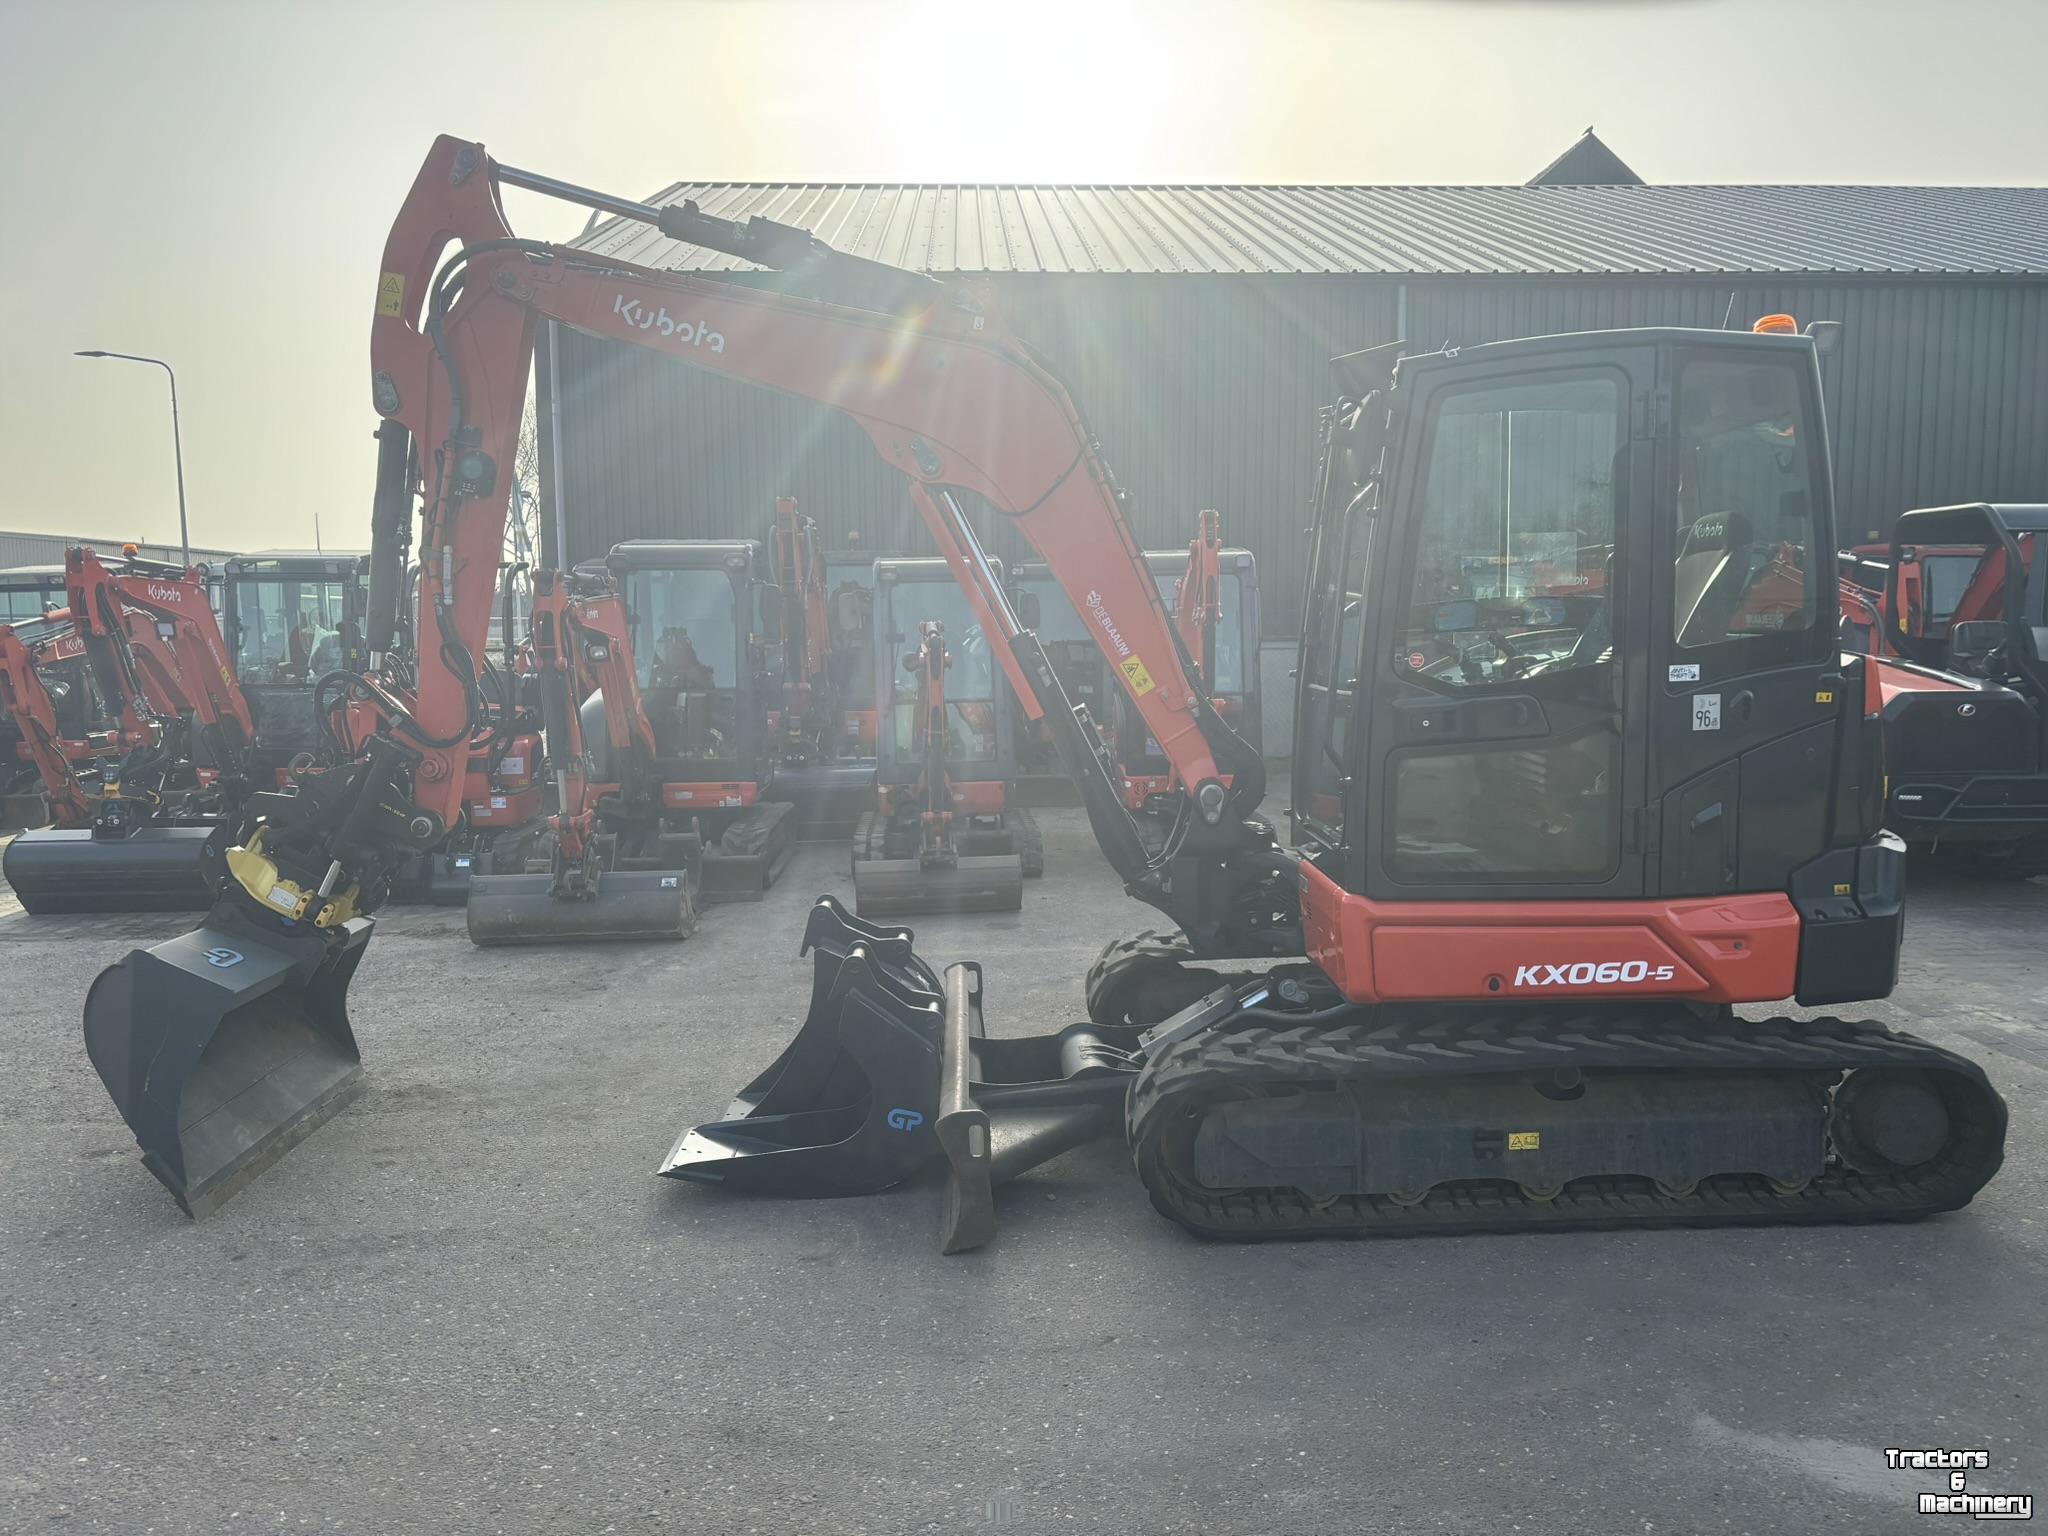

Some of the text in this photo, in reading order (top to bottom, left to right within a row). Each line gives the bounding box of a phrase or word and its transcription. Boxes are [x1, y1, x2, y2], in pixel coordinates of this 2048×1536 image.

[613, 294, 725, 353] Kubota
[148, 584, 181, 602] Kubota
[66, 637, 85, 651] Kub
[1696, 710, 1711, 727] 96
[1514, 961, 1675, 986] KX060-5
[888, 1108, 923, 1131] GP
